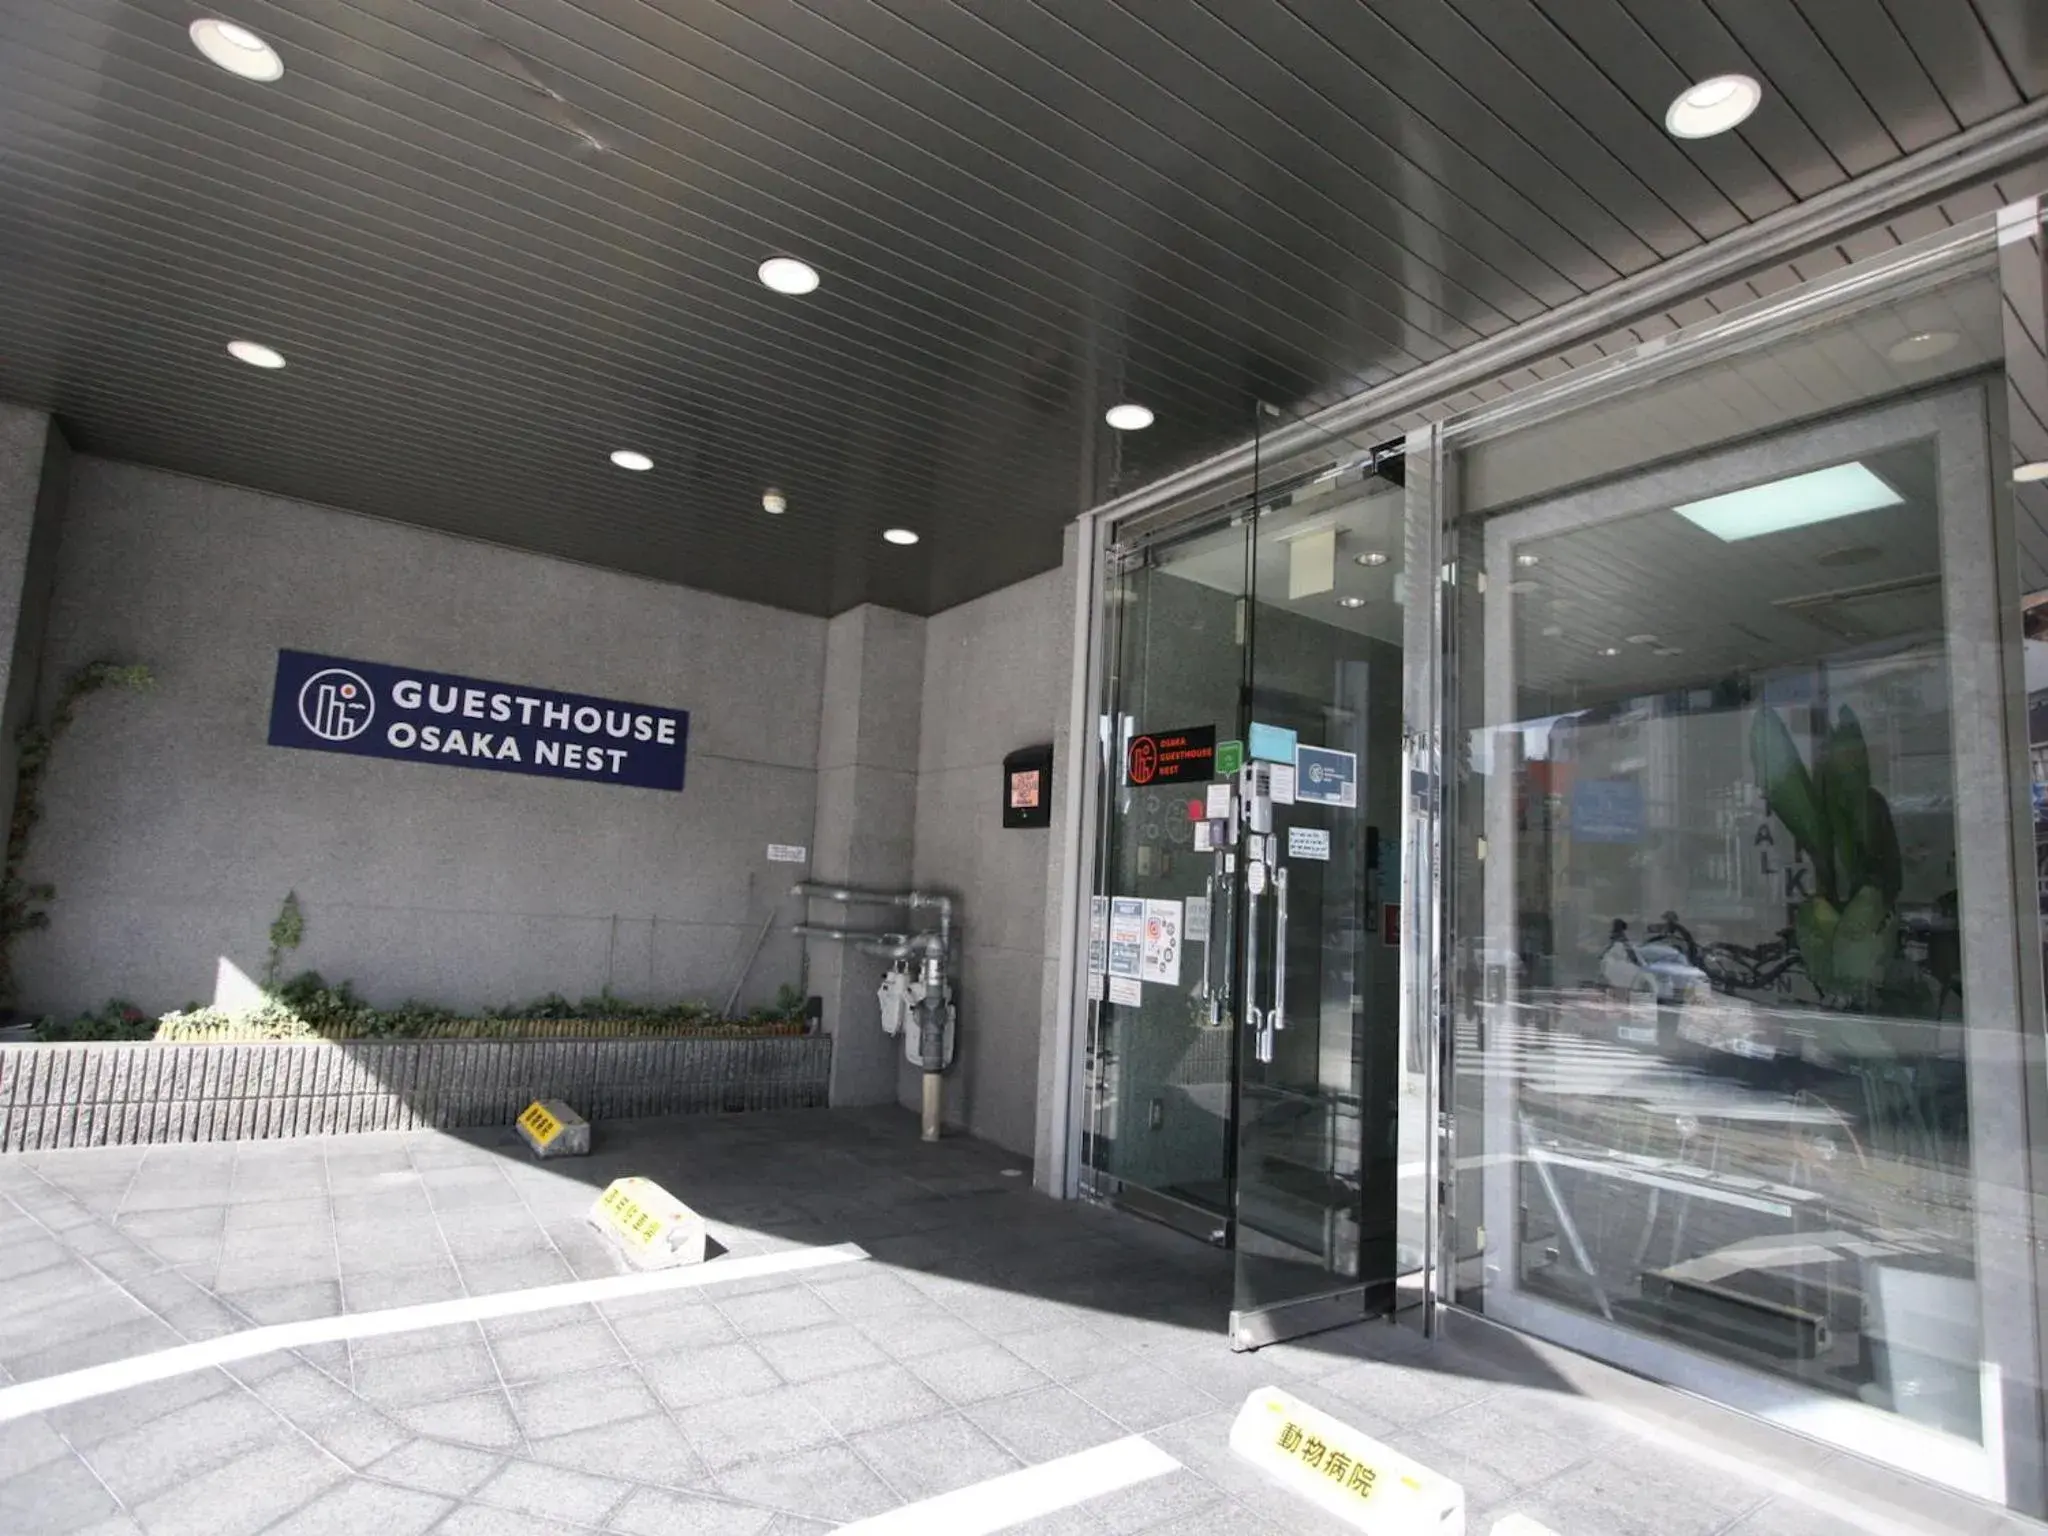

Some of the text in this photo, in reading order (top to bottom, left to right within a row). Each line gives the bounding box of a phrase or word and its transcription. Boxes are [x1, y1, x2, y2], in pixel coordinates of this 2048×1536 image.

[391, 679, 677, 745] GUESTHOUSE
[387, 722, 628, 774] OSAKA NEST
[1276, 1421, 1377, 1498] 動物病院
